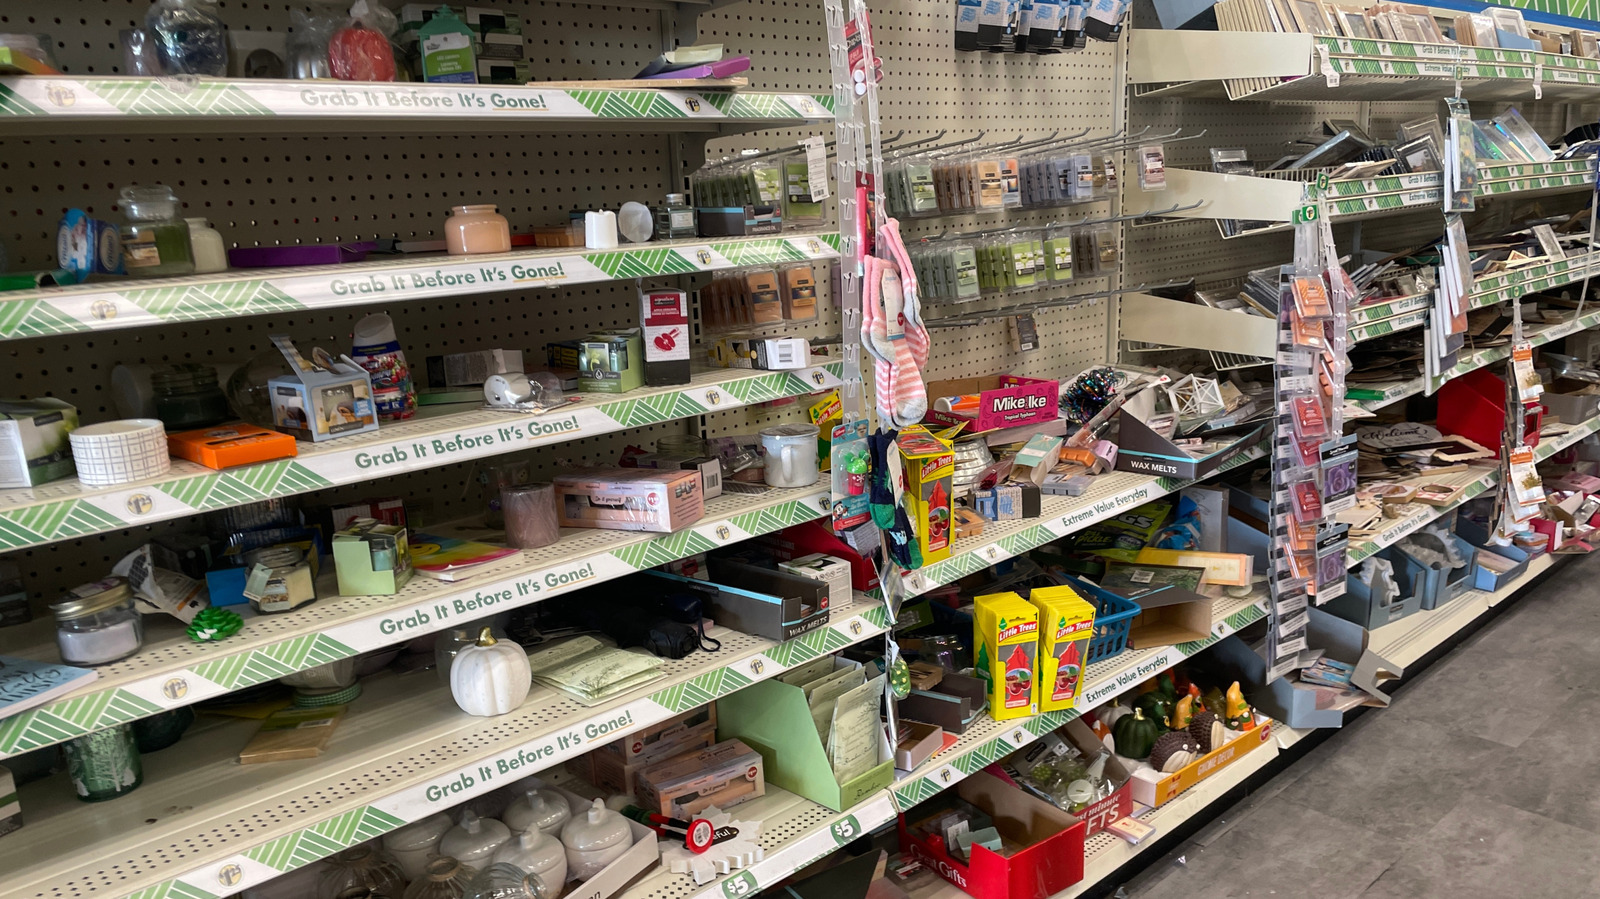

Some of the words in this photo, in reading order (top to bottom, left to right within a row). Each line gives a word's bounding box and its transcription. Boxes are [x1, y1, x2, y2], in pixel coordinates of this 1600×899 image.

[300, 89, 358, 106] Grab
[364, 91, 380, 106] It
[386, 90, 454, 108] Before
[458, 92, 486, 108] It's
[492, 93, 547, 108] Gone!
[330, 275, 386, 296] Grab
[392, 275, 406, 290] It
[412, 270, 476, 289] Before
[480, 268, 506, 282] It's
[511, 262, 565, 280] Gone!
[993, 396, 1026, 412] Mike
[1028, 395, 1046, 409] Ike
[355, 446, 408, 469] Grab
[412, 444, 427, 458] It
[432, 434, 494, 454] Before
[498, 426, 524, 442] It's
[528, 416, 580, 437] Gone!
[922, 464, 938, 479] Little
[938, 455, 952, 468] Trees
[1130, 460, 1150, 470] WAX
[1152, 464, 1177, 474] MELTS
[1062, 510, 1094, 527] Extreme
[1094, 500, 1116, 514] Value
[1116, 488, 1148, 506] Everyday
[380, 609, 430, 635] Grab
[434, 605, 448, 620] It
[452, 590, 512, 614] Before
[516, 579, 541, 597] It's
[544, 562, 596, 588] Gone!
[789, 625, 806, 637] WAX
[806, 616, 828, 631] MELTS
[999, 628, 1018, 641] Little
[1018, 622, 1036, 633] Trees
[1056, 626, 1074, 640] Little
[1076, 621, 1092, 632] Trees
[1086, 682, 1116, 703] Extreme
[1116, 672, 1137, 686] Value
[1136, 655, 1168, 676] Everyday
[426, 773, 475, 802] Grab
[478, 766, 493, 782] It
[496, 744, 554, 775] Before
[556, 732, 582, 750] It's
[584, 710, 634, 739] Gone!
[834, 819, 854, 838] $5
[1086, 804, 1120, 836] FTS
[726, 874, 750, 895] $5
[938, 861, 967, 888] Gifts
